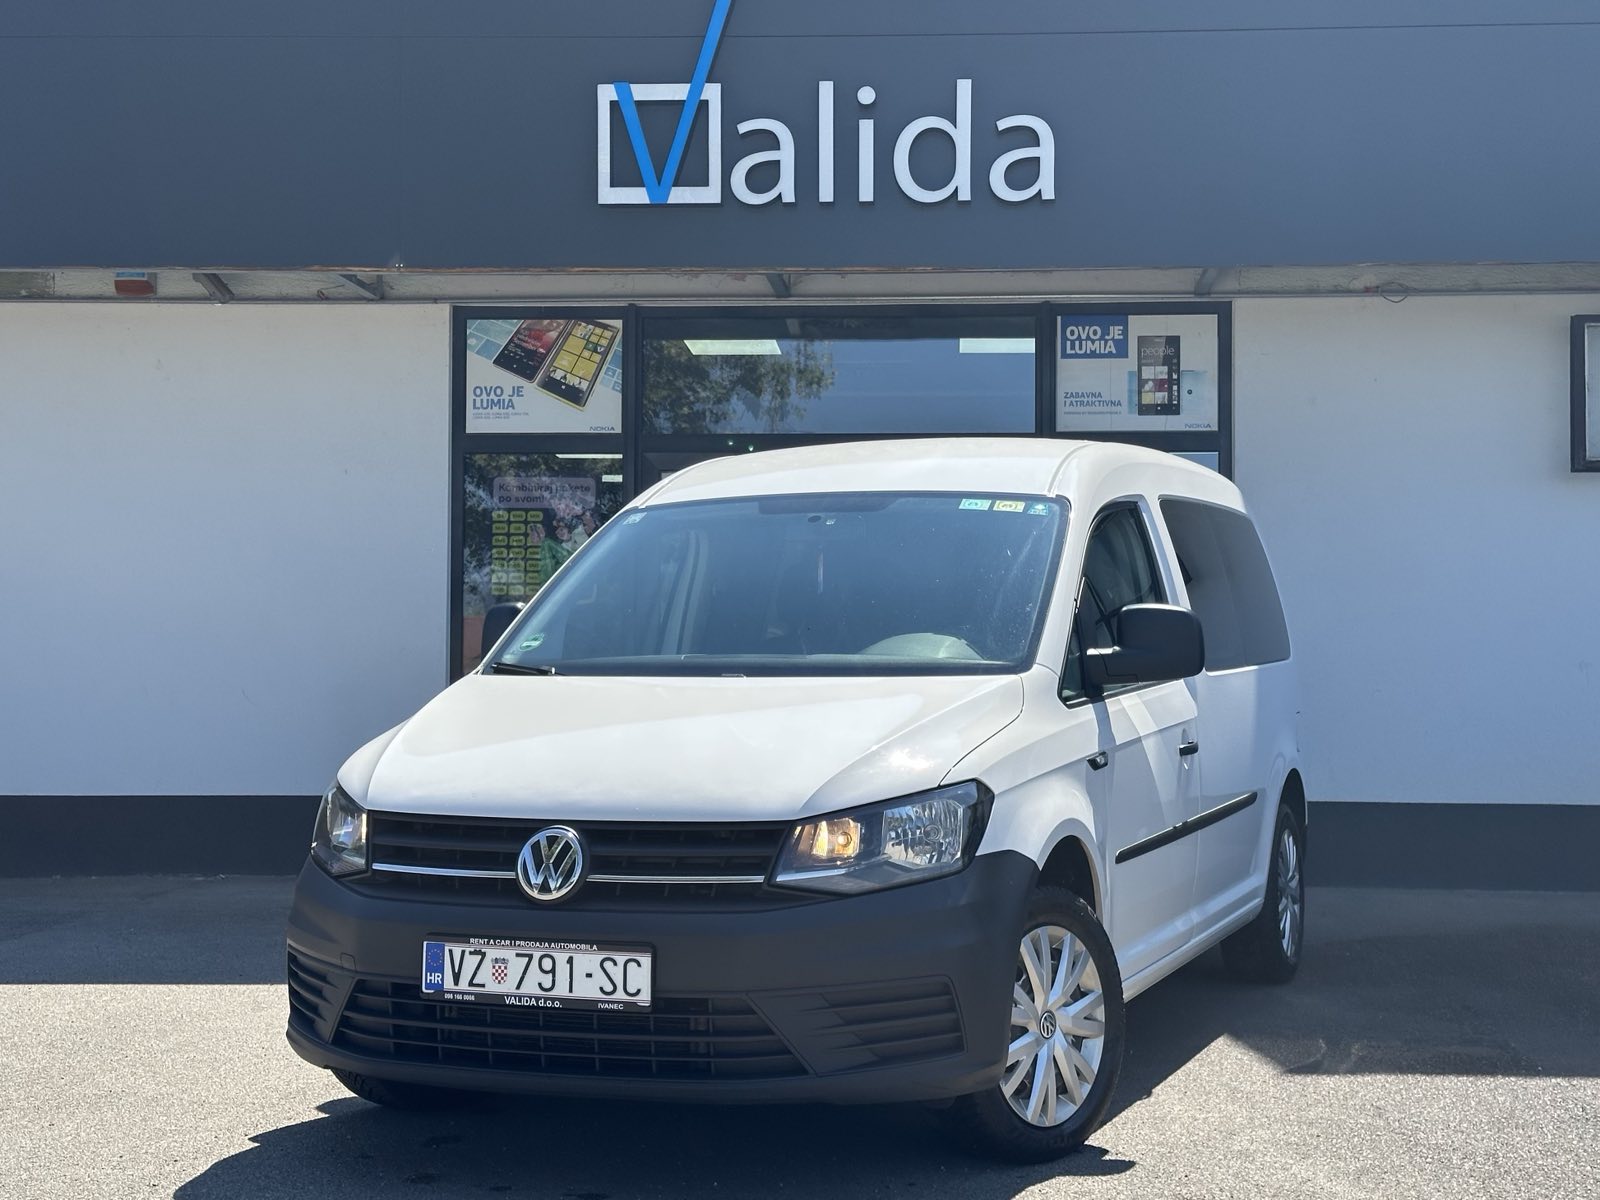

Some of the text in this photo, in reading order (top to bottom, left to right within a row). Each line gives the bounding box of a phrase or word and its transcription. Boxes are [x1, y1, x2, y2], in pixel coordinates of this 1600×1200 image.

[598, 0, 1056, 204] Valida
[1066, 325, 1123, 340] OVO JE
[1066, 340, 1116, 354] LUMIA
[1141, 345, 1175, 358] people
[472, 386, 525, 398] OVO JE
[1063, 391, 1103, 399] ZABAVNA
[472, 399, 515, 410] LUMIA
[516, 941, 549, 949] PRODAJA
[550, 943, 598, 951] AUTOMOBILA
[427, 972, 442, 984] HR
[504, 995, 562, 1008] VALIDA d.o.o.
